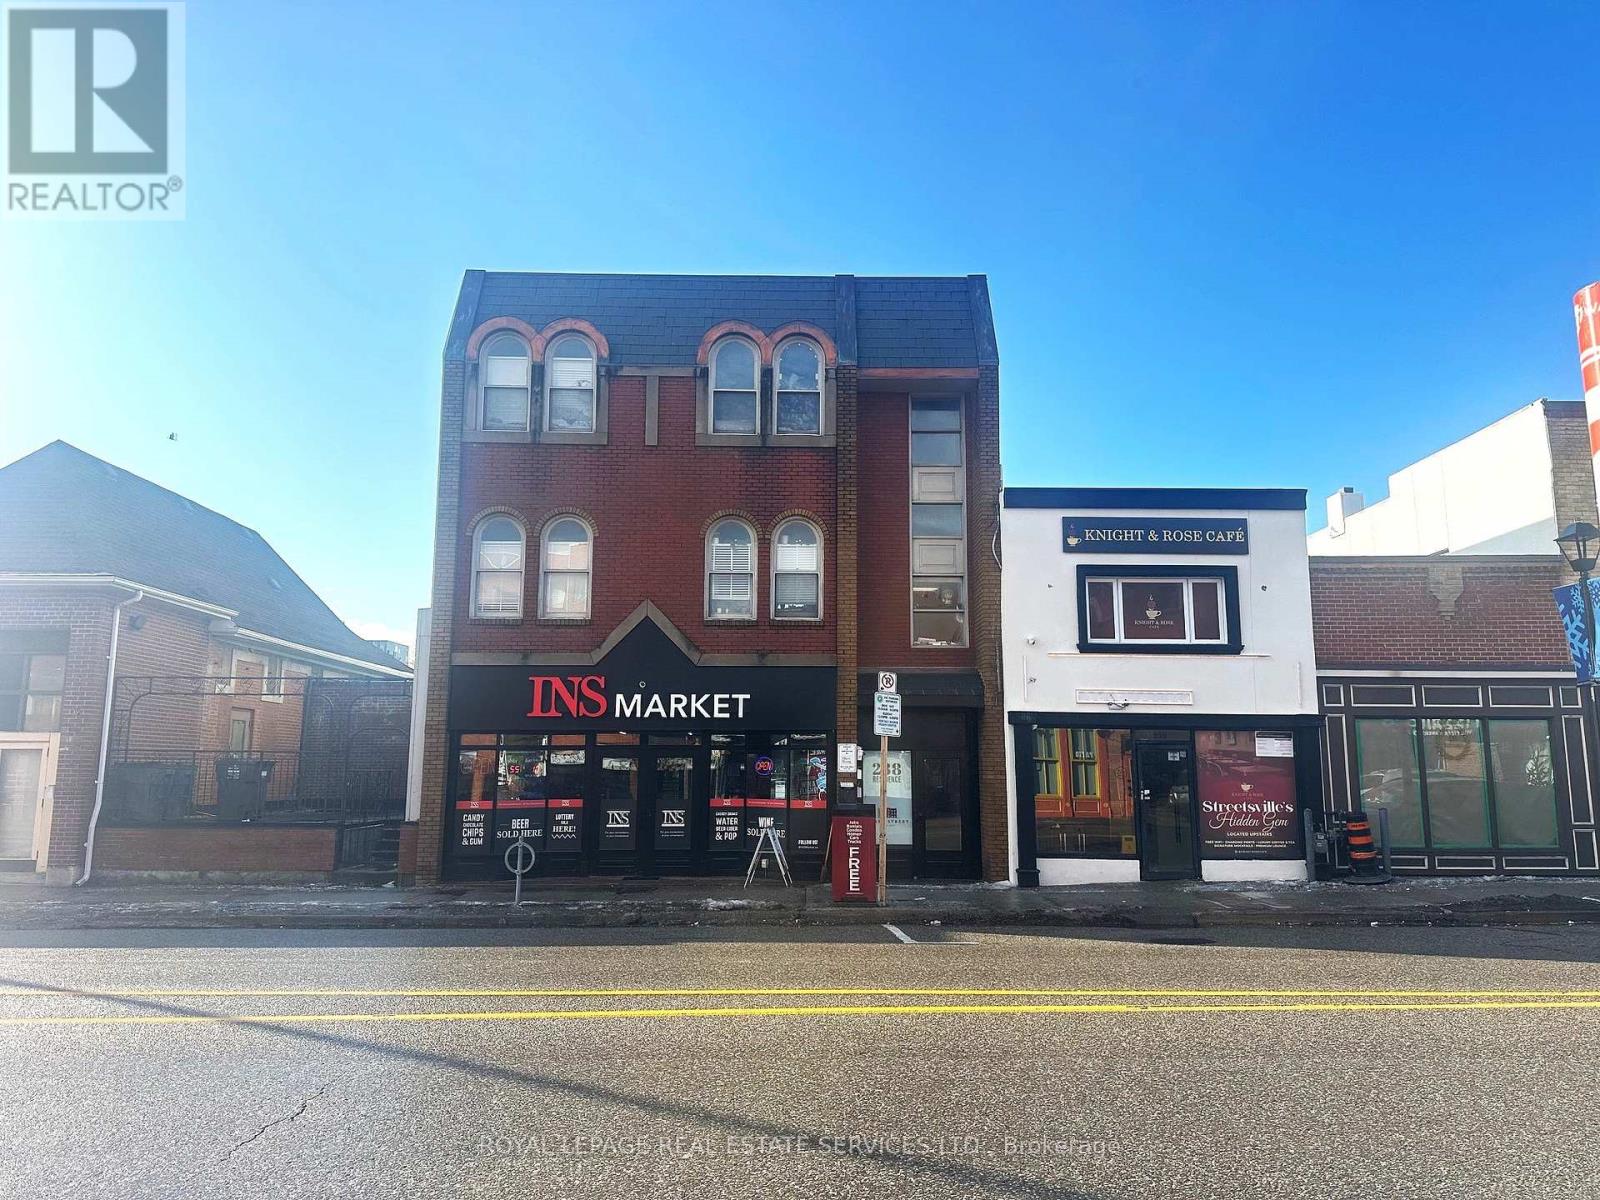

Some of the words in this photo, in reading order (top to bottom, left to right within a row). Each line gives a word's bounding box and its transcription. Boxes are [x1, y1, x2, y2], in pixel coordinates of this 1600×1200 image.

[1084, 529, 1144, 541] KNIGHT
[1148, 529, 1159, 541] &
[1162, 530, 1203, 542] ROSE
[1206, 527, 1245, 542] CAFÉ
[526, 675, 609, 718] INS
[614, 693, 751, 718] MARKET
[1202, 800, 1294, 813] Streetsville's
[463, 814, 485, 822] CANDY
[607, 811, 630, 826] INS
[662, 811, 685, 825] INS
[716, 818, 739, 826] WATER
[1209, 811, 1260, 829] Hidden
[1262, 811, 1289, 833] Gem
[511, 819, 530, 829] BEER
[462, 828, 484, 837] CHIPS
[496, 830, 519, 838] SOLD
[520, 829, 543, 838] HERE
[715, 832, 723, 840] &
[724, 832, 737, 840] POP
[462, 838, 469, 846] &
[849, 847, 860, 891] FREE
